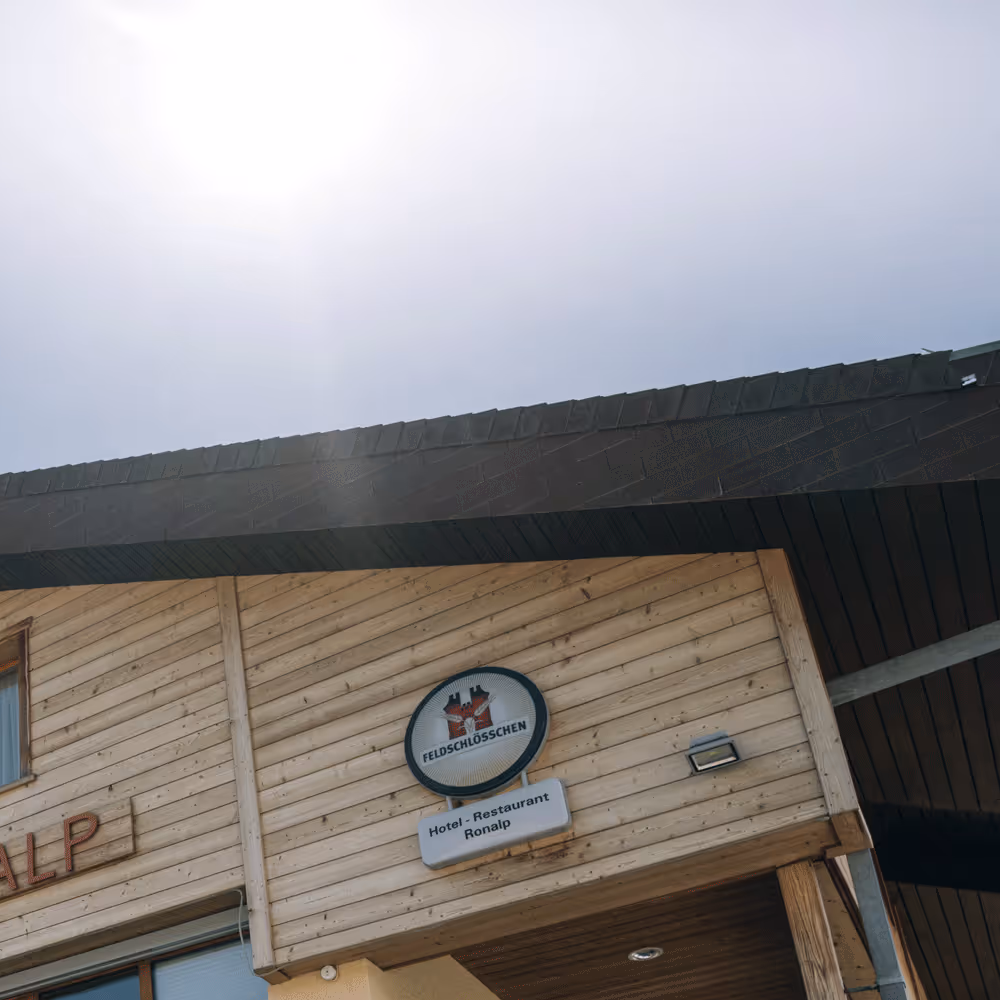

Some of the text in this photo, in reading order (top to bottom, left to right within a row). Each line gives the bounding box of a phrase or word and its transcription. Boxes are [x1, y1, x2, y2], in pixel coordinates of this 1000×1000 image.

[422, 720, 527, 763] FELDSCHLÖSSCHEN
[428, 817, 463, 837] Hotel
[473, 792, 550, 822] Restaurant
[464, 818, 511, 840] Ronalp
